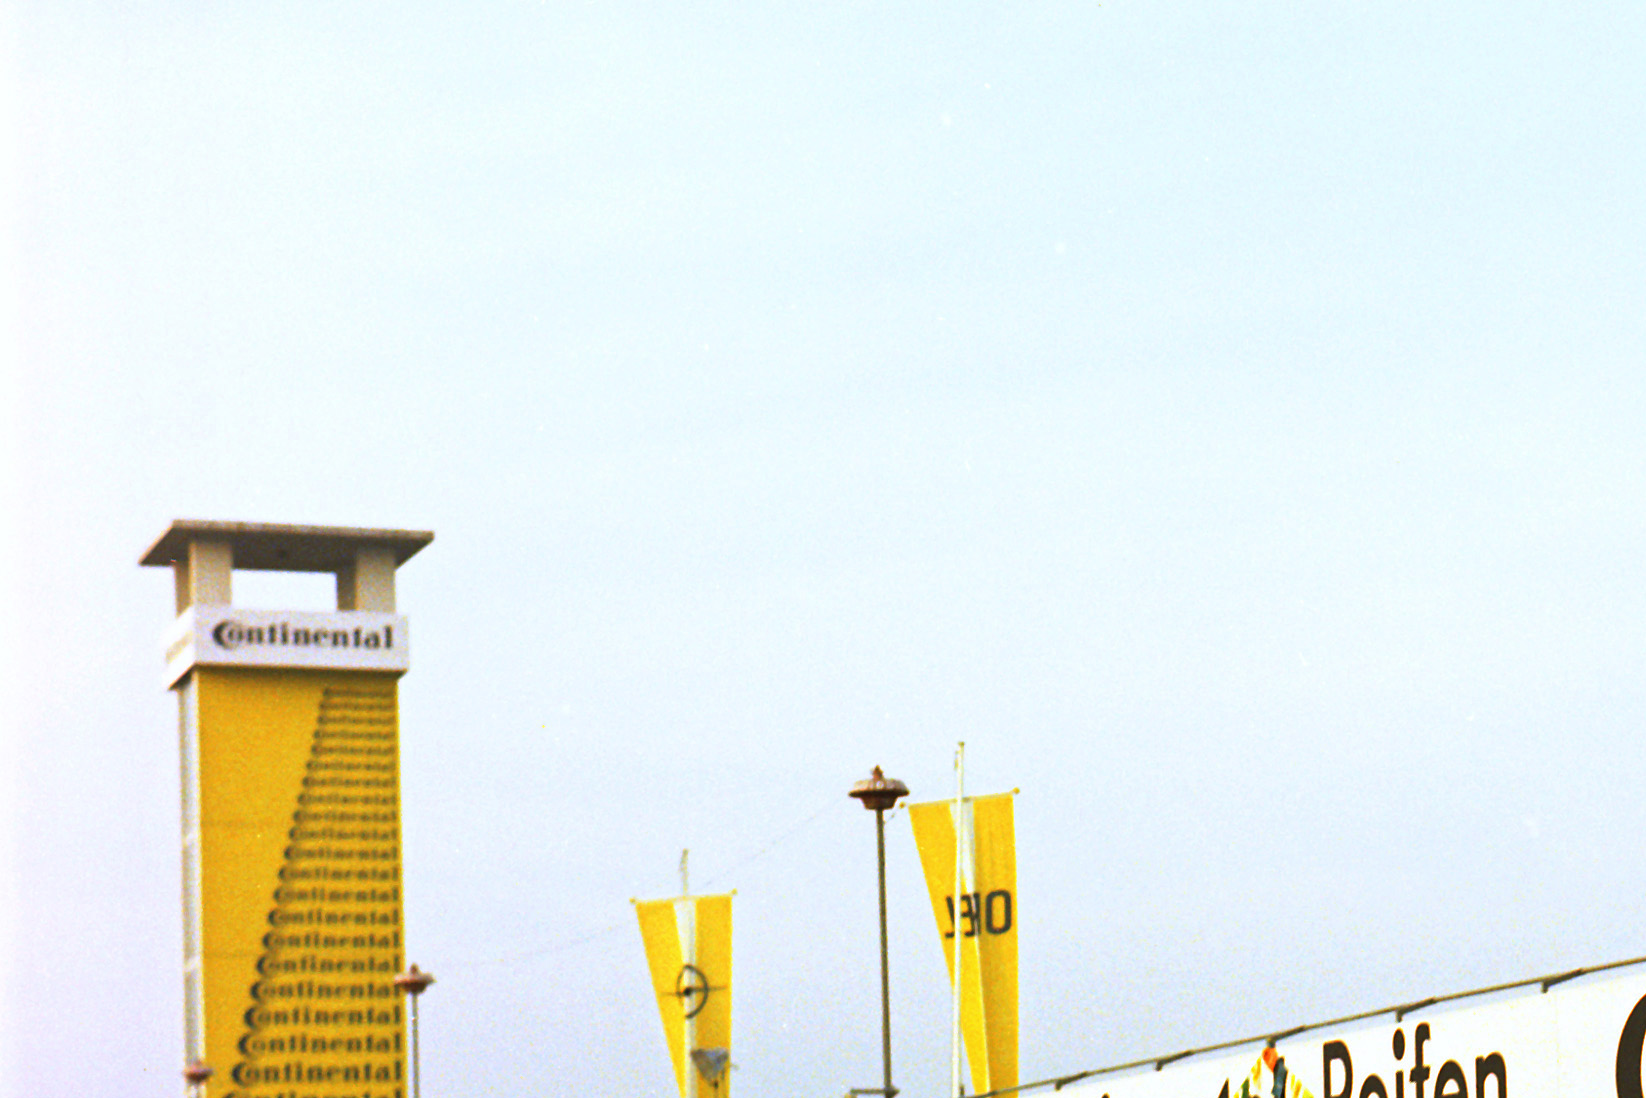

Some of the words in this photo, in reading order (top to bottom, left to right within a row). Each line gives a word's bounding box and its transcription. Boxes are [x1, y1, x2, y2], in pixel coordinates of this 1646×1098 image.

[212, 619, 393, 650] Continental
[262, 931, 400, 950] Continental
[256, 955, 400, 976] Continental
[250, 980, 401, 1002] Continental
[243, 1006, 401, 1029] Continental
[238, 1033, 401, 1059] Continental
[231, 1061, 401, 1088] Continental
